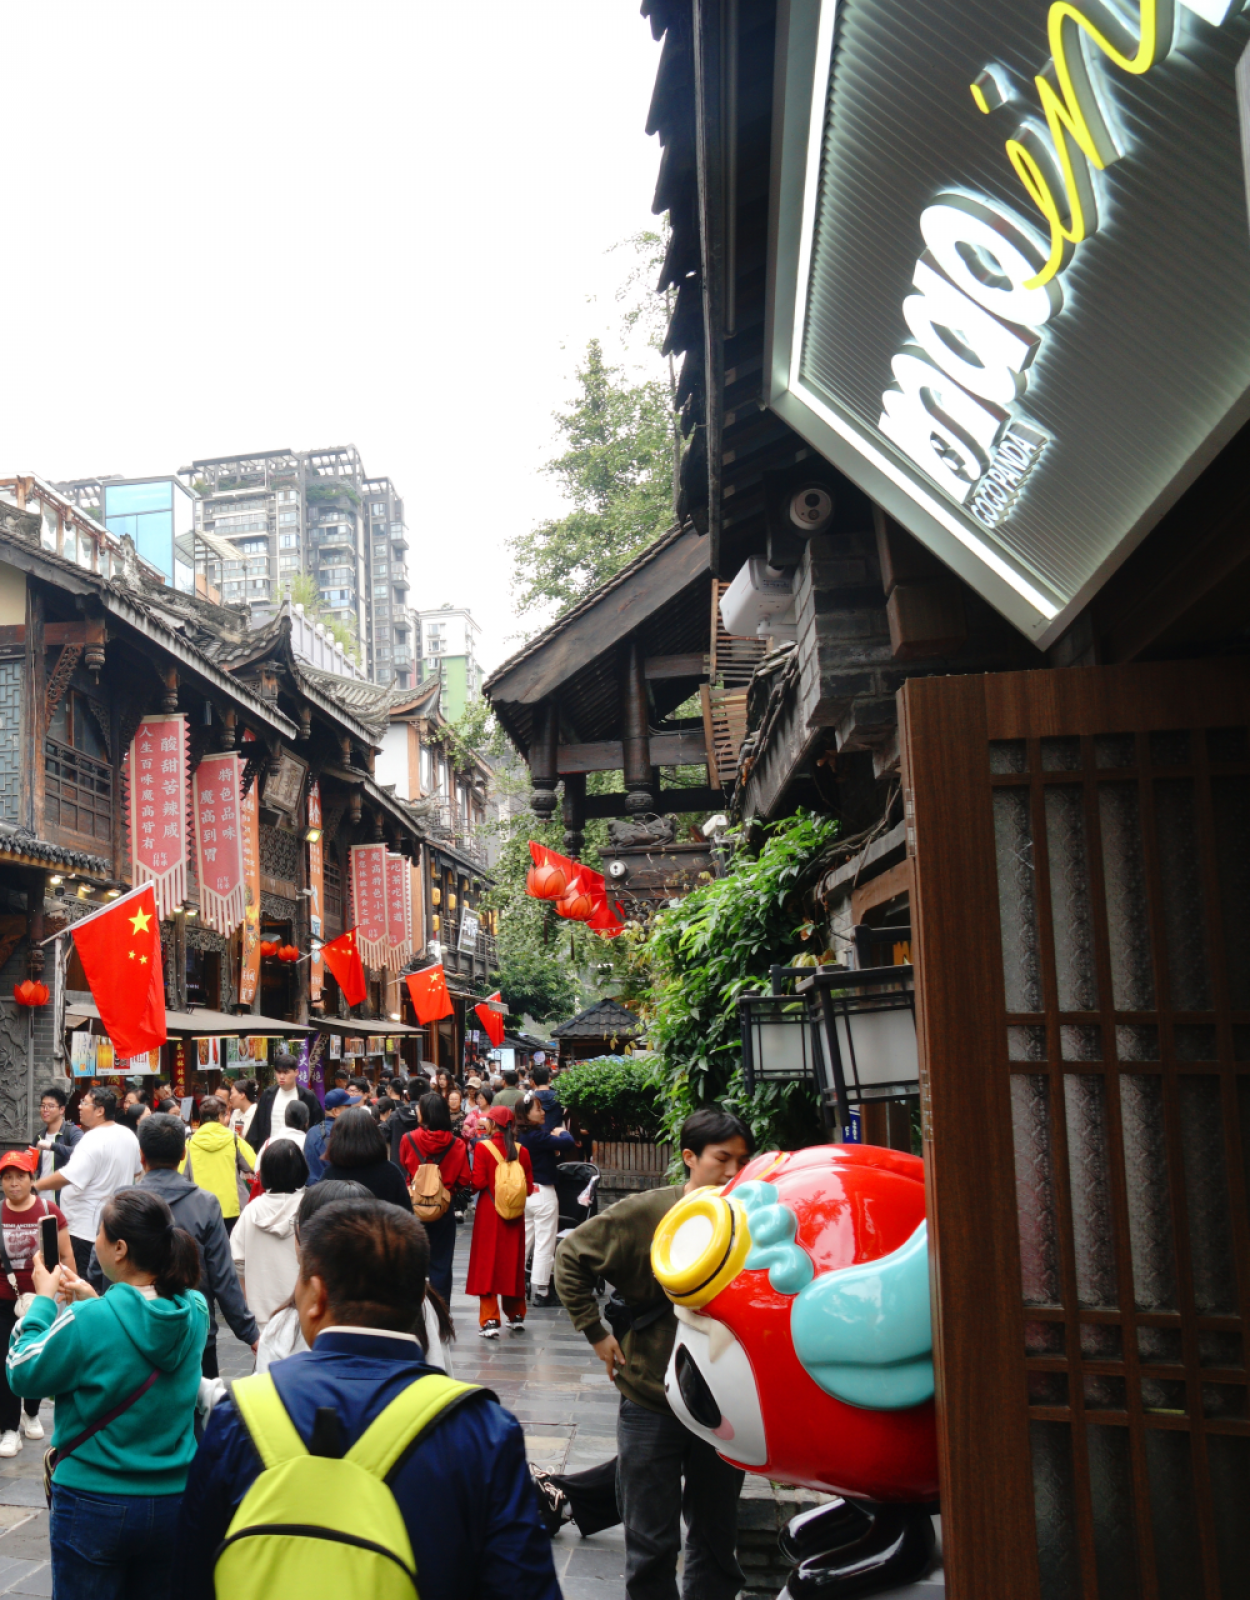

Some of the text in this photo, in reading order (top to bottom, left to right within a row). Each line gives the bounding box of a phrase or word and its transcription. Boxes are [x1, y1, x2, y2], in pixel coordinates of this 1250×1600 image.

[971, 431, 1038, 529] GOGO PANDA
[139, 726, 156, 849] 人生百味魔高皆有
[160, 735, 180, 838] 酸甜苦辣咸
[200, 789, 218, 862] 魔高到胃
[218, 767, 237, 841] 特色品味
